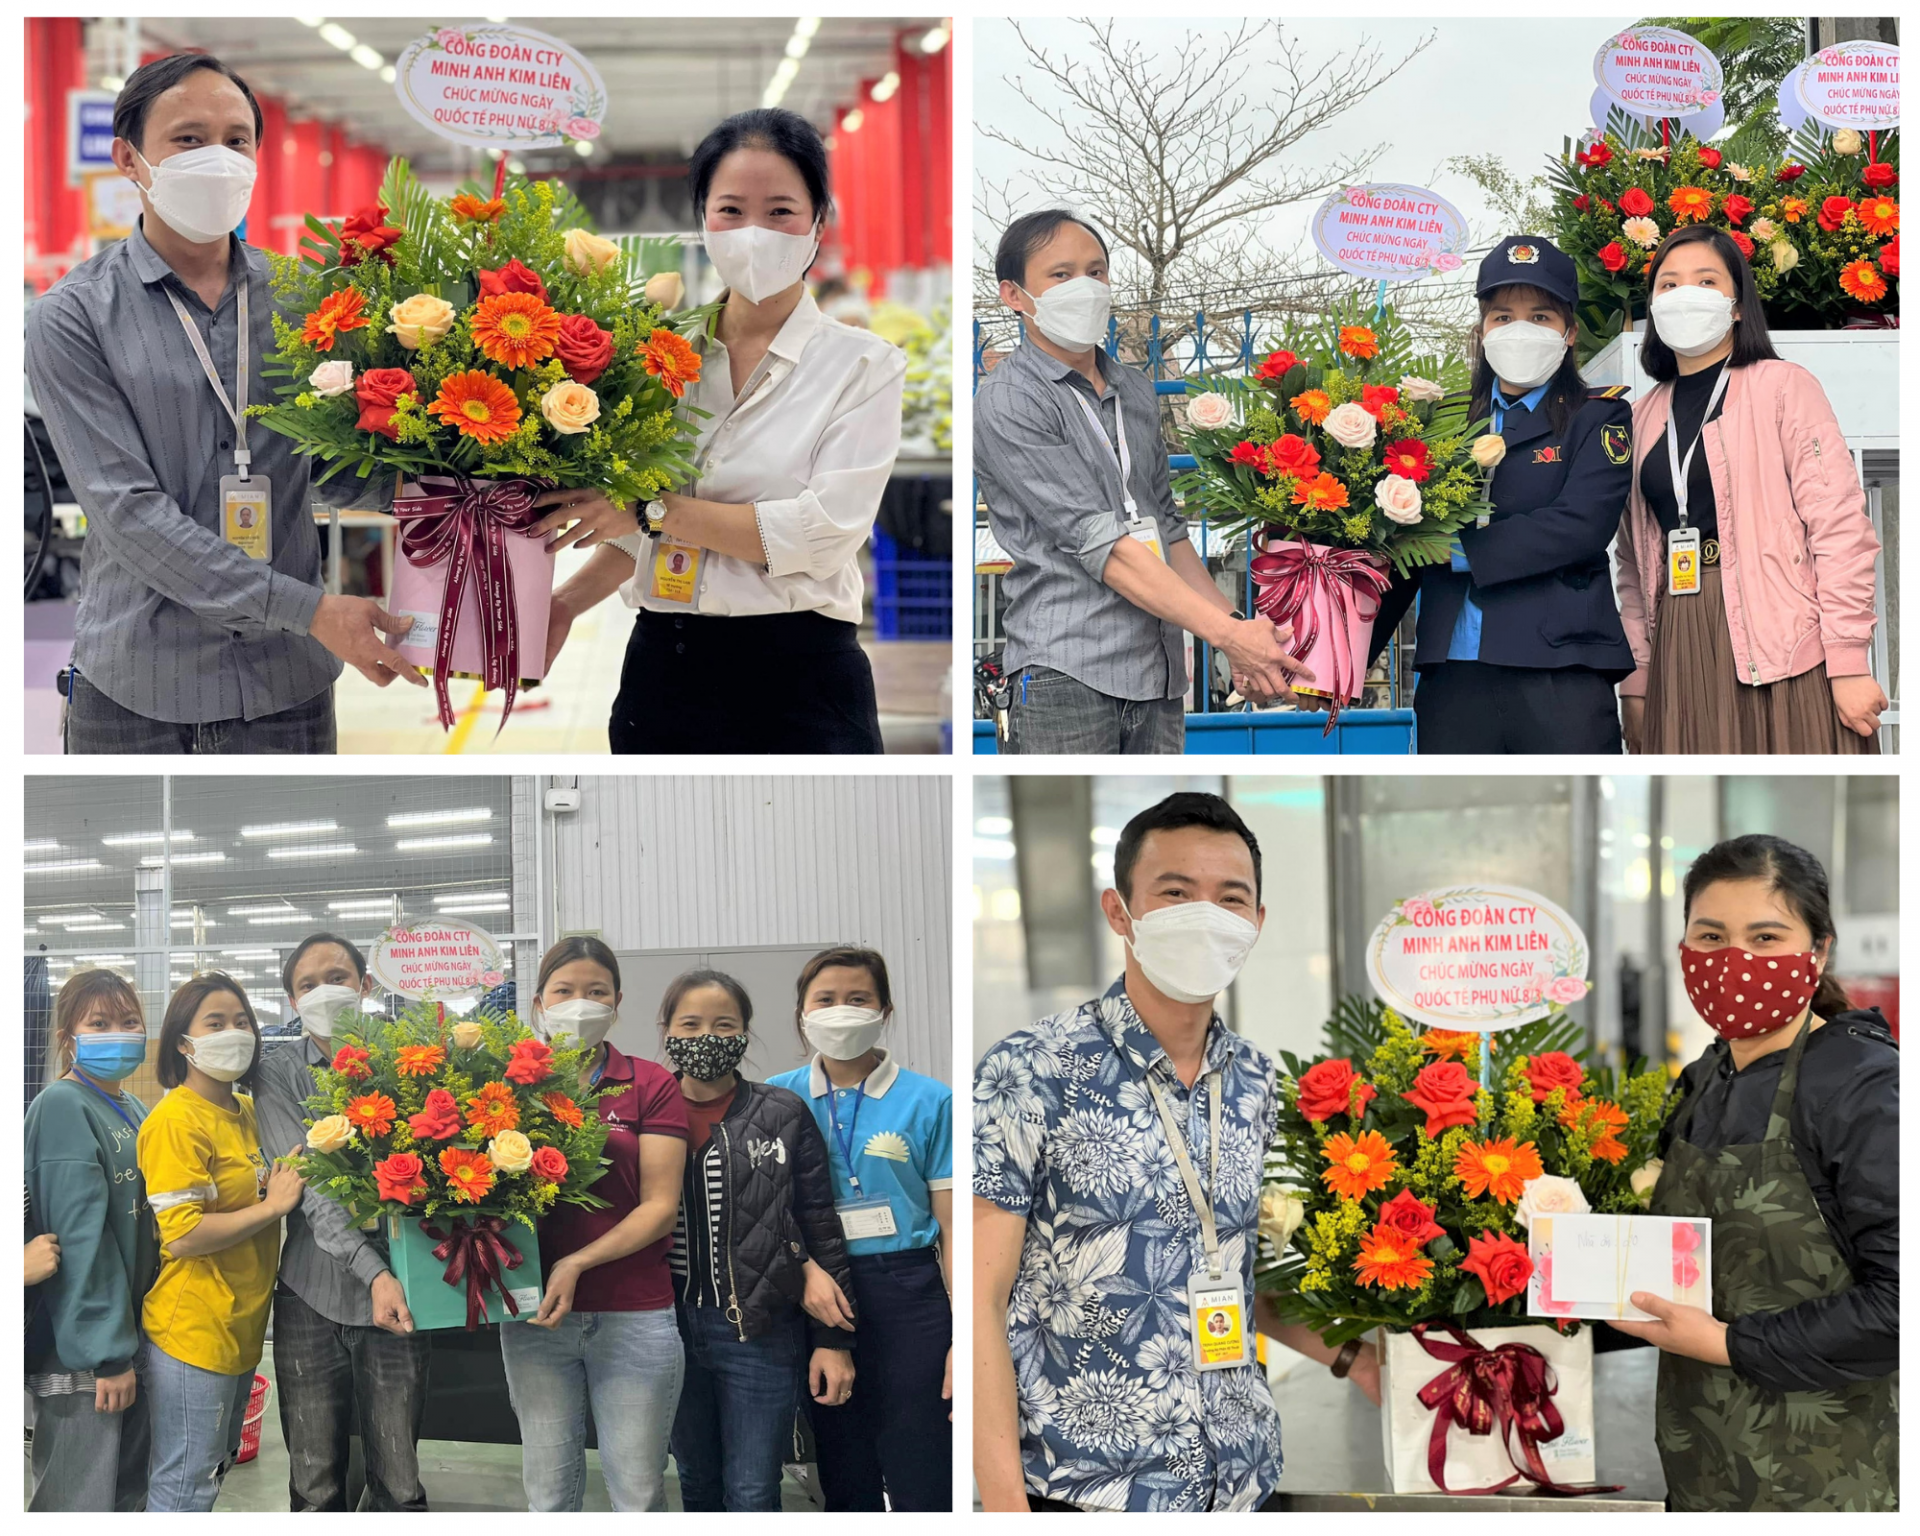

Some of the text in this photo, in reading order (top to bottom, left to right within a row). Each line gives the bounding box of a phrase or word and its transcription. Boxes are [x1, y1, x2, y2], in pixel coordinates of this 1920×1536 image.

[445, 39, 563, 67] CÔNG ĐOÀN CTY
[1622, 38, 1694, 55] CÔNG ĐOÀN CTY
[1616, 56, 1700, 73] MINH ANH KIM LIÊN
[1826, 54, 1900, 67] CÔNG ĐOÀN CT
[431, 60, 570, 91] MINH ANH KIM LIÊN
[1625, 72, 1692, 88] CHÚC MỪNG NGÀY
[1818, 72, 1844, 83] MINH
[1846, 72, 1868, 82] ANH
[1870, 72, 1888, 83] KIM
[443, 84, 554, 110] CHÚC MỪNG NGÀY
[1621, 87, 1696, 104] QUỐC TẾ PHỤ NỮ 8/3
[1828, 87, 1850, 98] CHÚC
[1852, 87, 1878, 98] MỪNG
[1824, 102, 1848, 116] QUỐC
[1849, 102, 1860, 114] TẾ
[1860, 104, 1877, 118] PHỤ
[1878, 102, 1892, 116] NỮ
[434, 106, 558, 134] QUỐC TẾ PHỤ NỮ 8/3
[1351, 194, 1440, 216] CÔNG ĐOÀN CTY
[1339, 212, 1442, 234] MINH ANH KIM LIÊN
[1346, 230, 1428, 250] CHÚC MỪNG NGÀY
[1339, 246, 1429, 268] QUỐC TẾ PHỤ NỮ 8/3
[454, 566, 462, 584] Always
[413, 620, 438, 632] Flower
[1414, 904, 1537, 927] CÔNG ĐOÀN CTY
[396, 930, 470, 944] CÔNG ĐOÀN CTY
[1403, 930, 1548, 954] MINH ANH KIM LIÊN
[390, 944, 479, 958] MINH ANH KIM LIÊN
[401, 960, 472, 974] CHÚC MỪNG NGÀY
[1420, 959, 1534, 980] CHÚC MỪNG NGÀY
[398, 977, 422, 990] QUỐC
[1414, 986, 1542, 1009] QUỐC TẾ PHỤ NỮ 8/3
[108, 1122, 136, 1152] just
[747, 1137, 786, 1170] Hey
[113, 1165, 137, 1184] be
